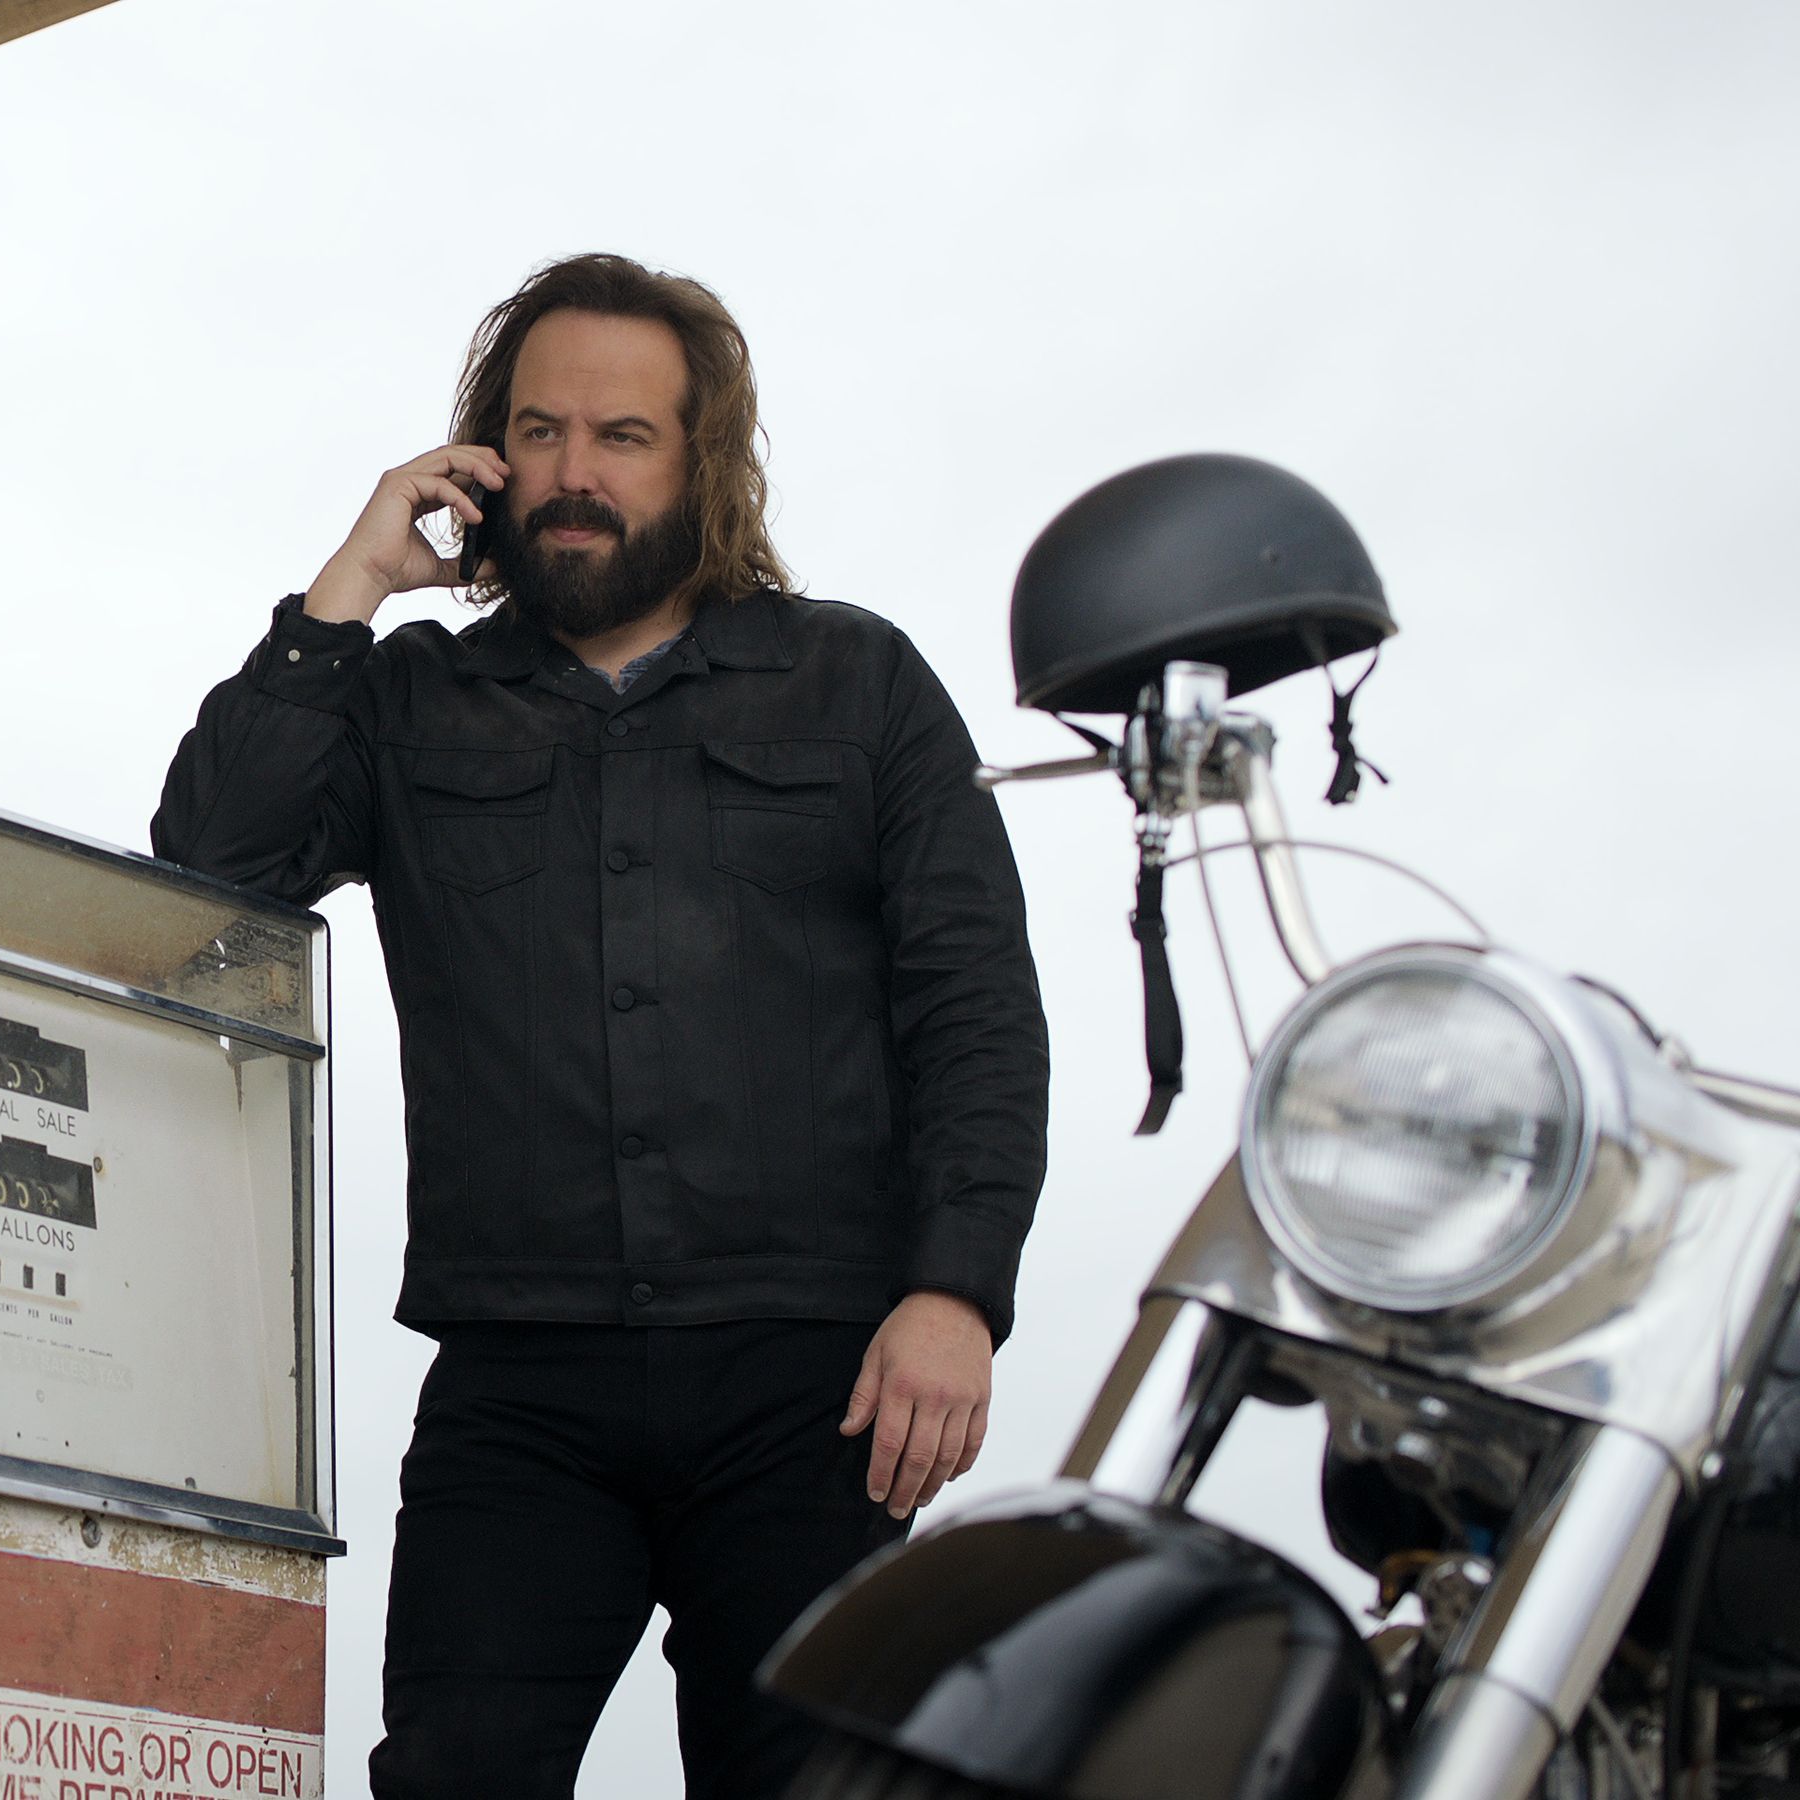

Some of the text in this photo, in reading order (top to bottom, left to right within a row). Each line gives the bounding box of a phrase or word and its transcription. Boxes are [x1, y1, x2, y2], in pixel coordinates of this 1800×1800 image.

[37, 1107, 76, 1137] SALE
[28, 1308, 40, 1319] PER
[49, 1312, 73, 1326] GALLON
[139, 1732, 192, 1785] OR
[206, 1740, 302, 1799] OPEN
